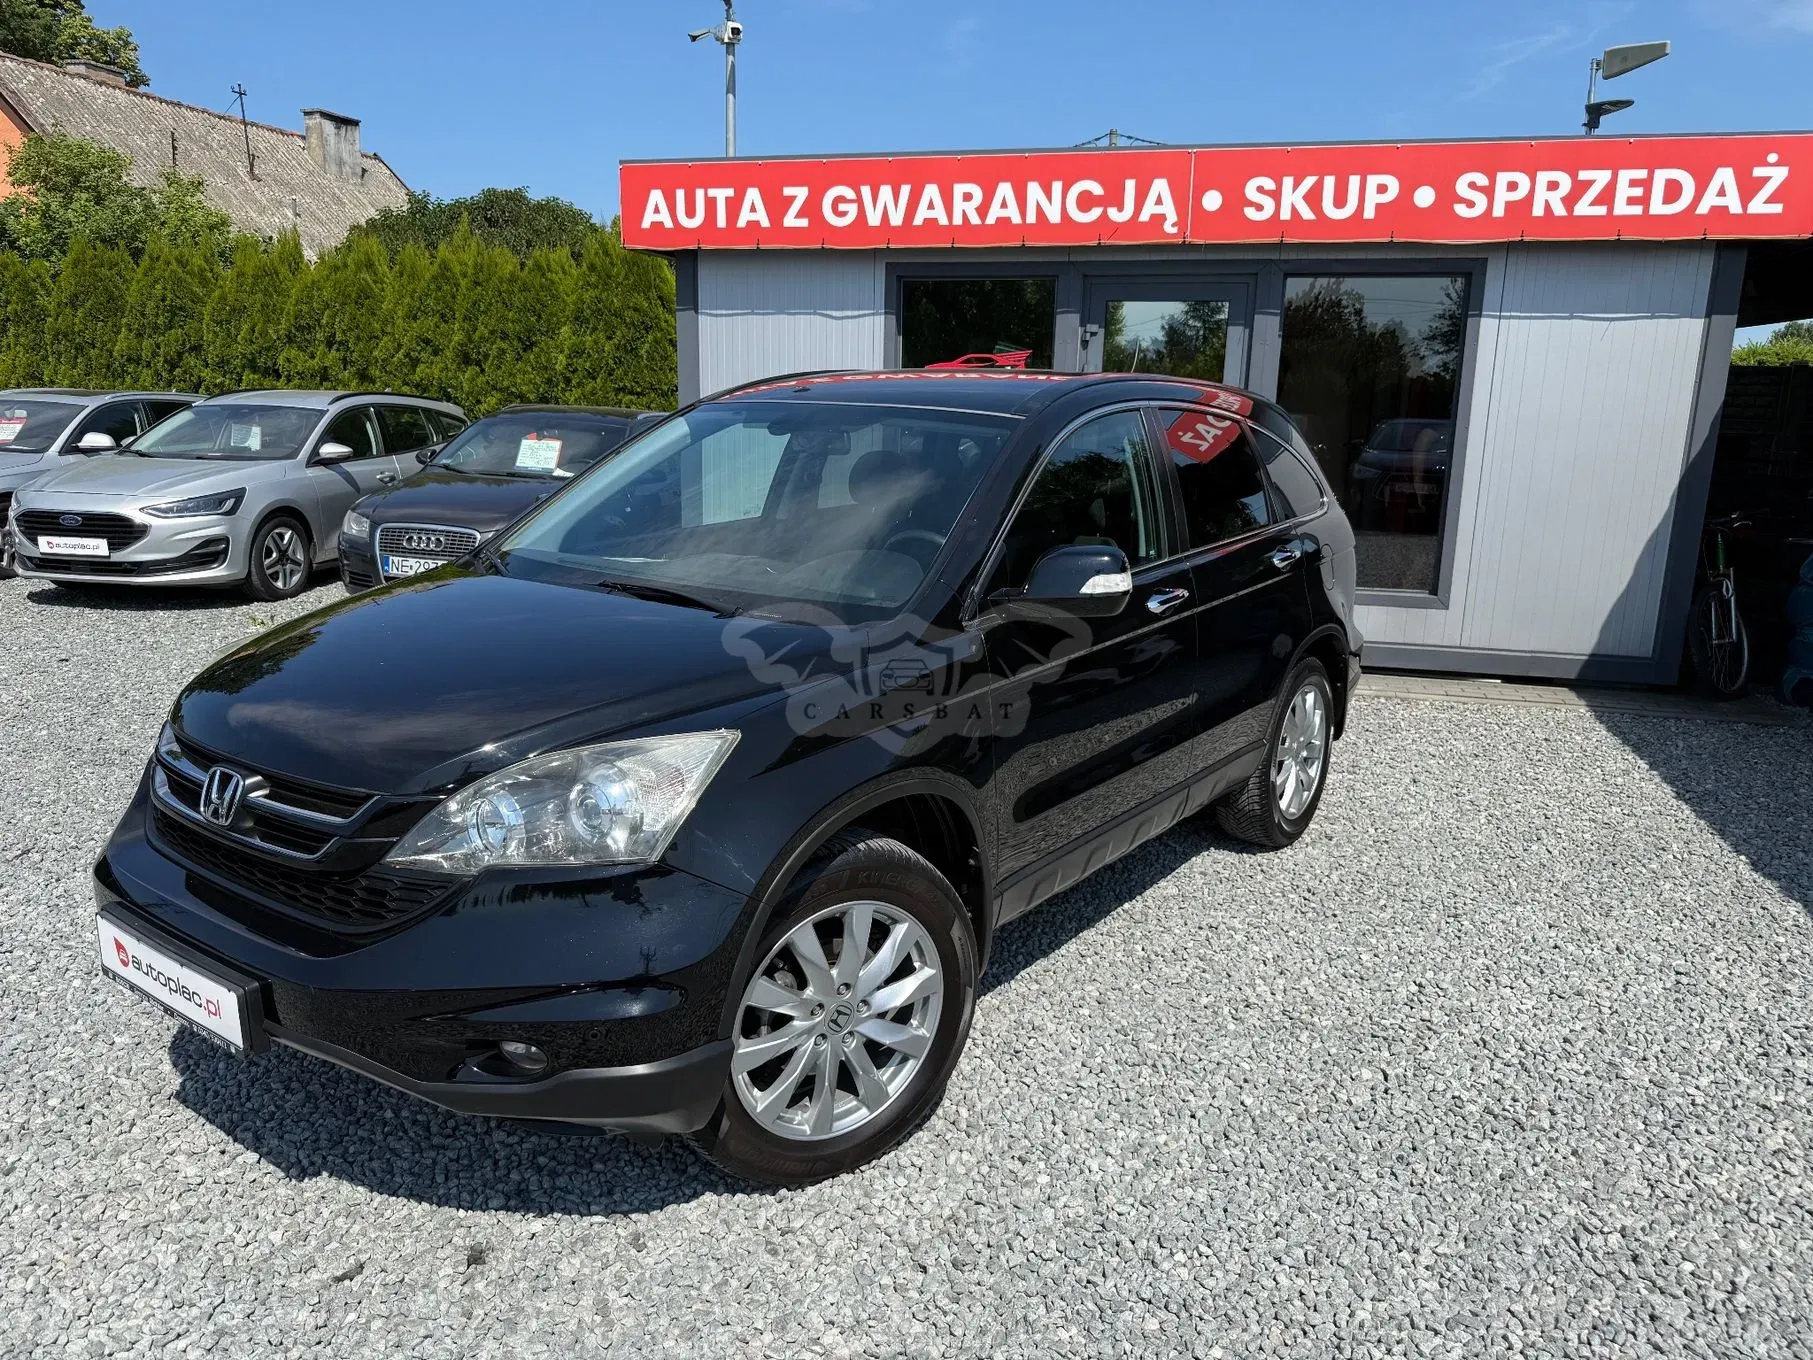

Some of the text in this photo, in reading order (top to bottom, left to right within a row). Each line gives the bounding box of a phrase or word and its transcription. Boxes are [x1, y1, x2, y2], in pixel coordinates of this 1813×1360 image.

[641, 152, 1789, 234] AUTA Z GWARANCJĄ SKUP SPRZEDAŻ
[391, 559, 410, 573] NE
[131, 954, 222, 1019] autoplac.pl
